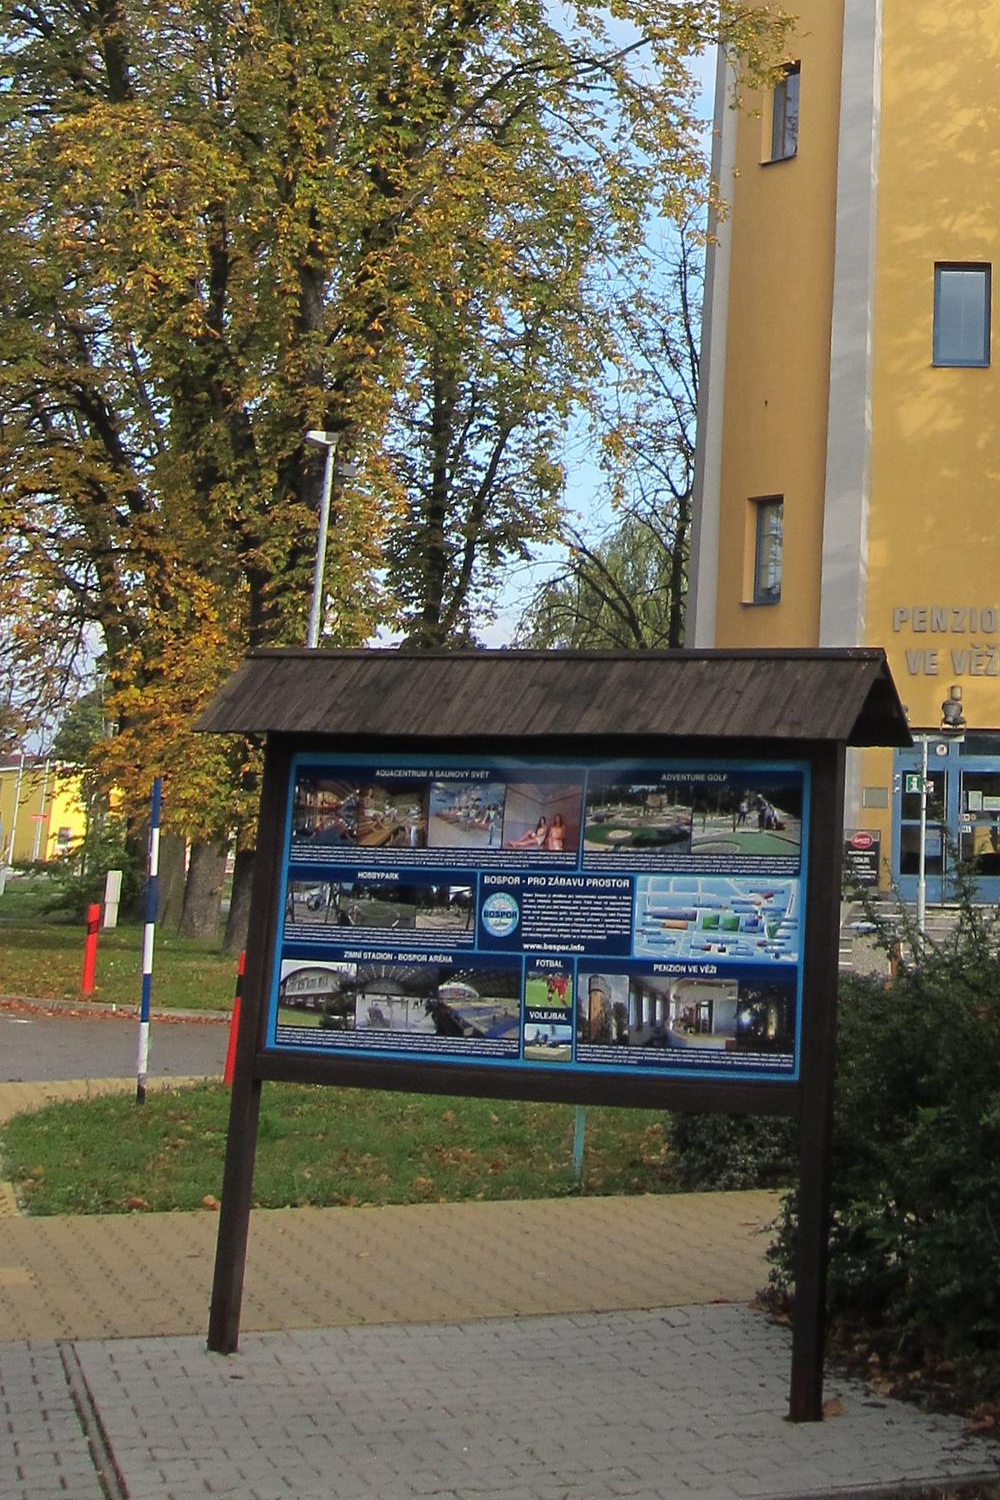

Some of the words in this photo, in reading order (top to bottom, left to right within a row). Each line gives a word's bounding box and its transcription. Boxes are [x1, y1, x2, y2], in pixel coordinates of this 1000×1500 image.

[905, 648, 938, 676] VE
[375, 769, 428, 779] AQUACENTRUM
[661, 773, 706, 782] ADVENTURE
[707, 774, 728, 783] GOLF
[357, 871, 400, 881] HOBBYPARK
[484, 875, 520, 885] BOSPOR
[527, 877, 546, 887] PRO
[547, 876, 584, 887] ZÁBAVU
[586, 878, 630, 888] PROSTOR
[483, 910, 518, 919] BOSPOR
[522, 942, 585, 952] www.bospor.info
[343, 950, 362, 959] ZIMNÍ
[363, 952, 393, 961] STADION
[397, 953, 428, 963] BOSPOR
[428, 953, 453, 964] ARÉNA
[536, 959, 563, 968] FOTBAL
[653, 963, 686, 973] PENZION
[687, 965, 698, 974] VE
[529, 1011, 567, 1021] VOLEJBAL
